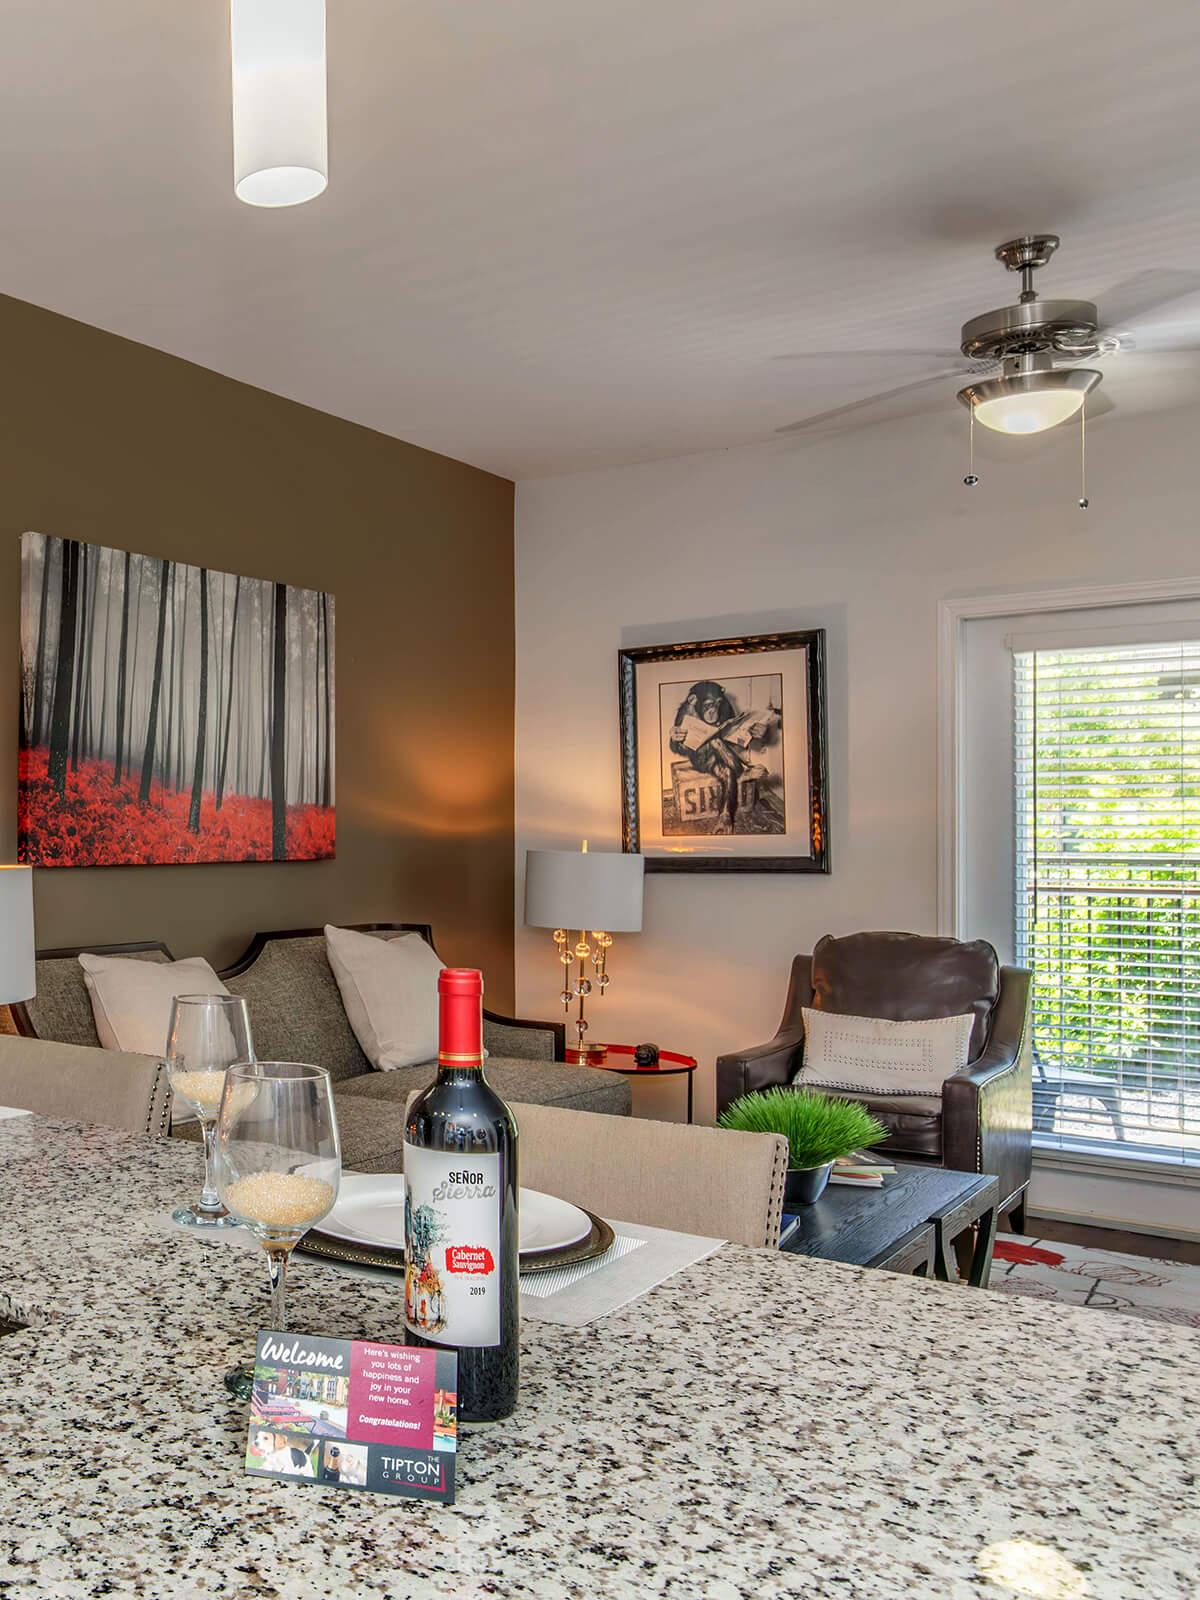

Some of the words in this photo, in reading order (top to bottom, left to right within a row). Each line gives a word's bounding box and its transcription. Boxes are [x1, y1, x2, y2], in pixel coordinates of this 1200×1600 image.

[449, 1170, 484, 1185] SEÑOR
[432, 1180, 497, 1203] Sierra
[451, 1249, 485, 1261] Cabernet
[452, 1259, 485, 1271] Sauvignon
[469, 1287, 486, 1296] 2019
[260, 1337, 344, 1370] Welcome
[364, 1348, 389, 1358] Here's
[390, 1352, 421, 1364] wishing
[371, 1360, 385, 1369] you
[387, 1361, 402, 1371] lots
[403, 1364, 412, 1372] of
[362, 1370, 402, 1382] happiness
[404, 1375, 420, 1384] and
[370, 1382, 382, 1392] joy
[393, 1385, 411, 1395] your
[368, 1394, 385, 1402] new
[387, 1396, 412, 1406] home.
[359, 1414, 421, 1430] Congratulations!
[427, 1455, 440, 1463] THE
[381, 1456, 440, 1477] TIPTON
[382, 1471, 440, 1485] GROUP
